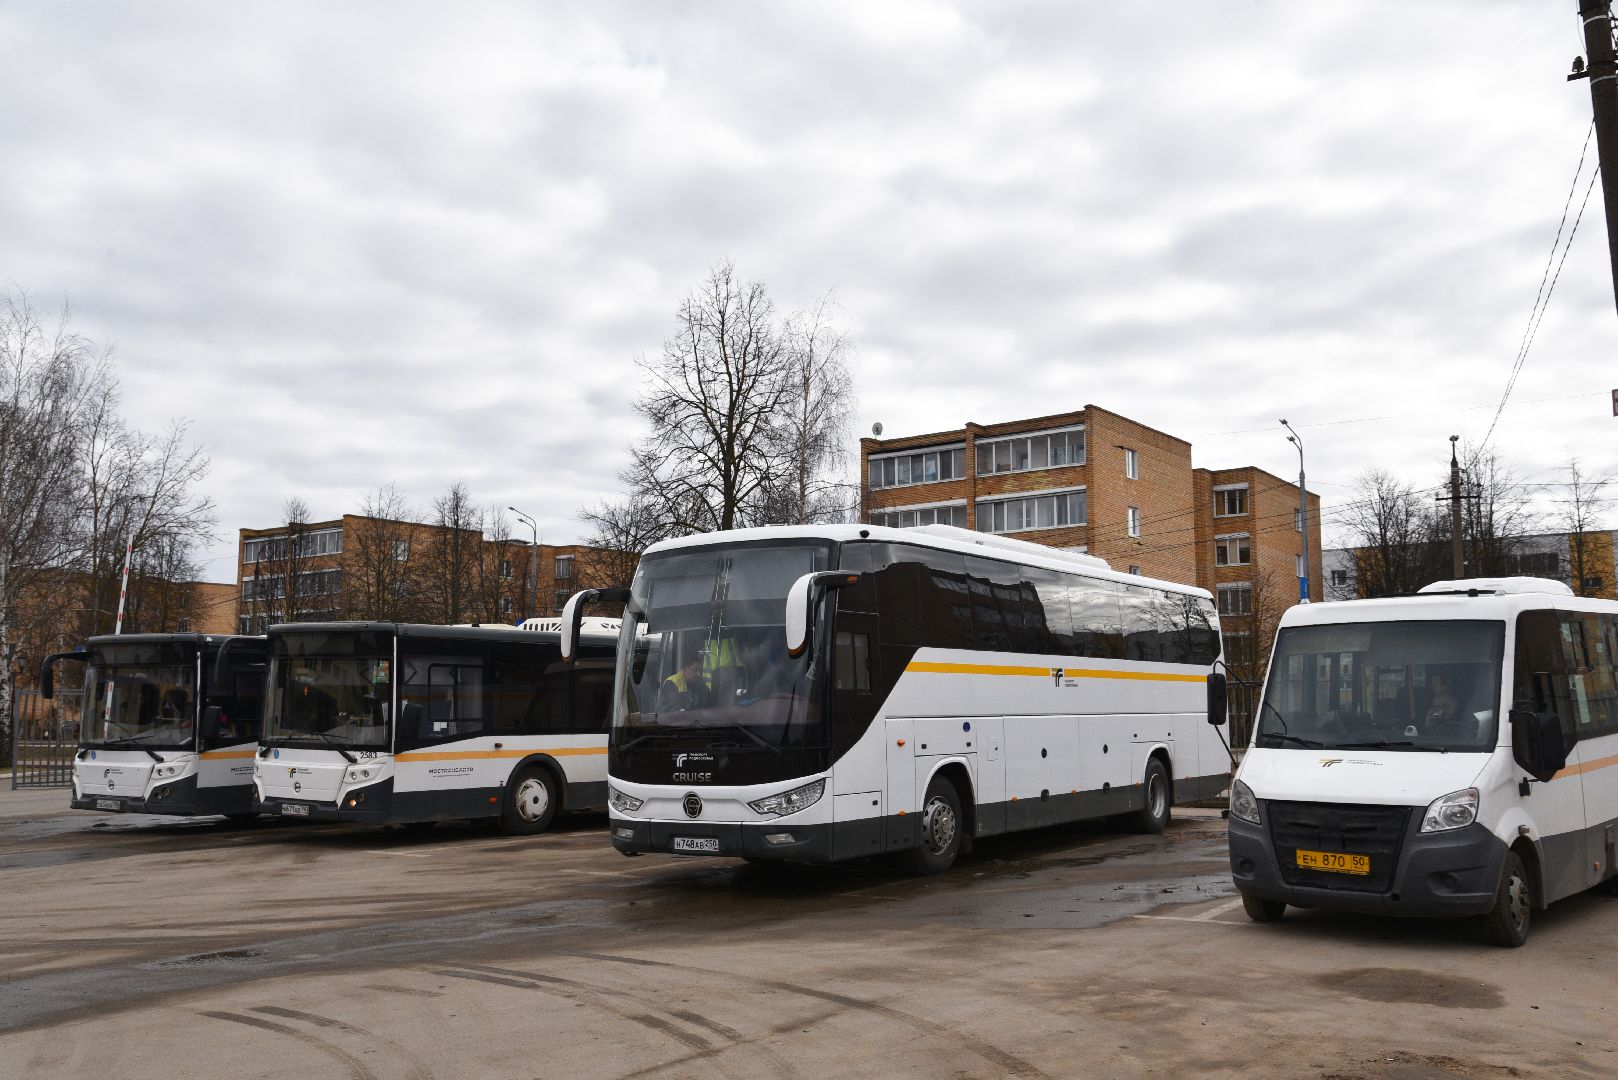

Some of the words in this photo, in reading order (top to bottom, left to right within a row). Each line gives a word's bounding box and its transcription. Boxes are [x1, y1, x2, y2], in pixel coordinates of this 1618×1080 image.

[360, 751, 378, 759] 2583
[672, 772, 712, 782] CRUISE
[1322, 854, 1345, 867] 870
[1352, 856, 1365, 866] 50
